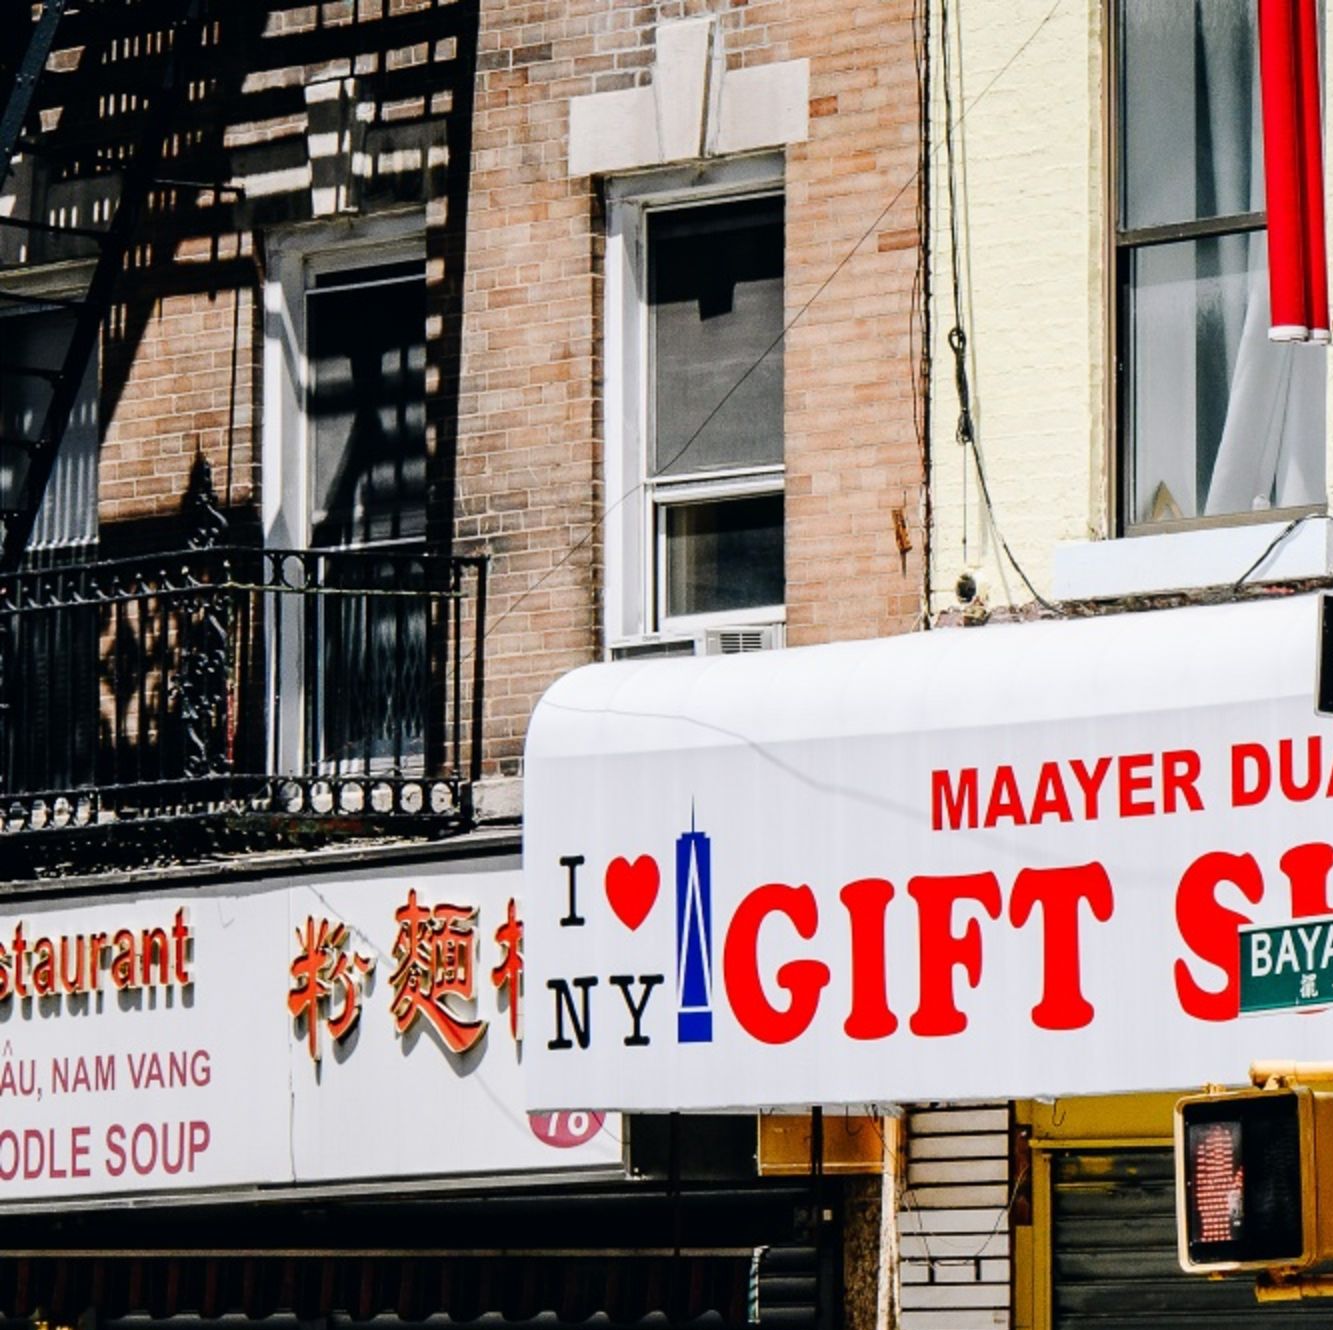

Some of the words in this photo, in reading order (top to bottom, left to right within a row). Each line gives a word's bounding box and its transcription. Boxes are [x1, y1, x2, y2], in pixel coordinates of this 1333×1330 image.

[931, 746, 1204, 831] MAAYER
[559, 855, 585, 927] I
[723, 861, 1114, 1045] GIFT
[547, 974, 664, 1050] NY
[52, 1054, 116, 1094] NAM
[129, 1047, 212, 1089] VANG
[105, 1120, 210, 1176] SOUP
